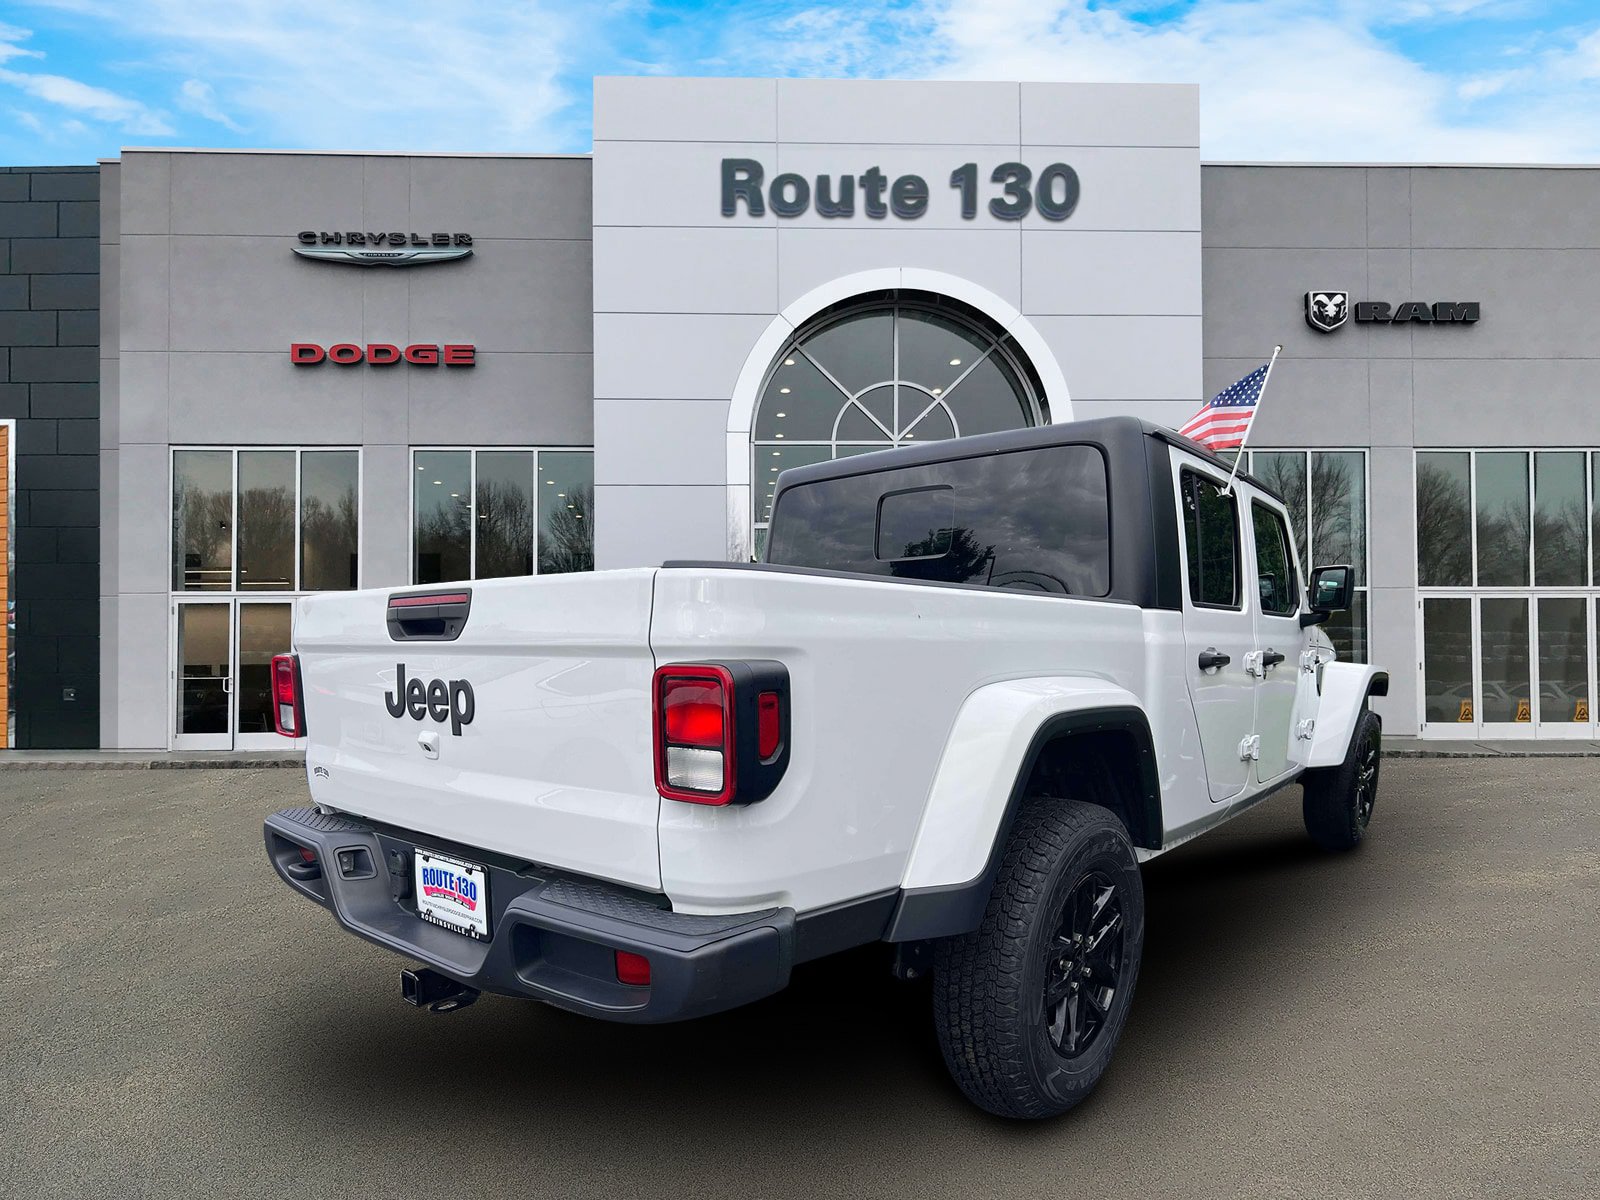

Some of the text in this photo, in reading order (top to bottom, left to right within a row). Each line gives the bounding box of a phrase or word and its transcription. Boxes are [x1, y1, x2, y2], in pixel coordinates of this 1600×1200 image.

[721, 158, 1081, 221] Route 130
[297, 231, 473, 246] CHRYSLER
[1355, 302, 1481, 326] RAM
[290, 343, 476, 368] DODGE
[385, 663, 476, 736] Jeep
[422, 868, 454, 891] ROUTE
[457, 876, 477, 901] 130
